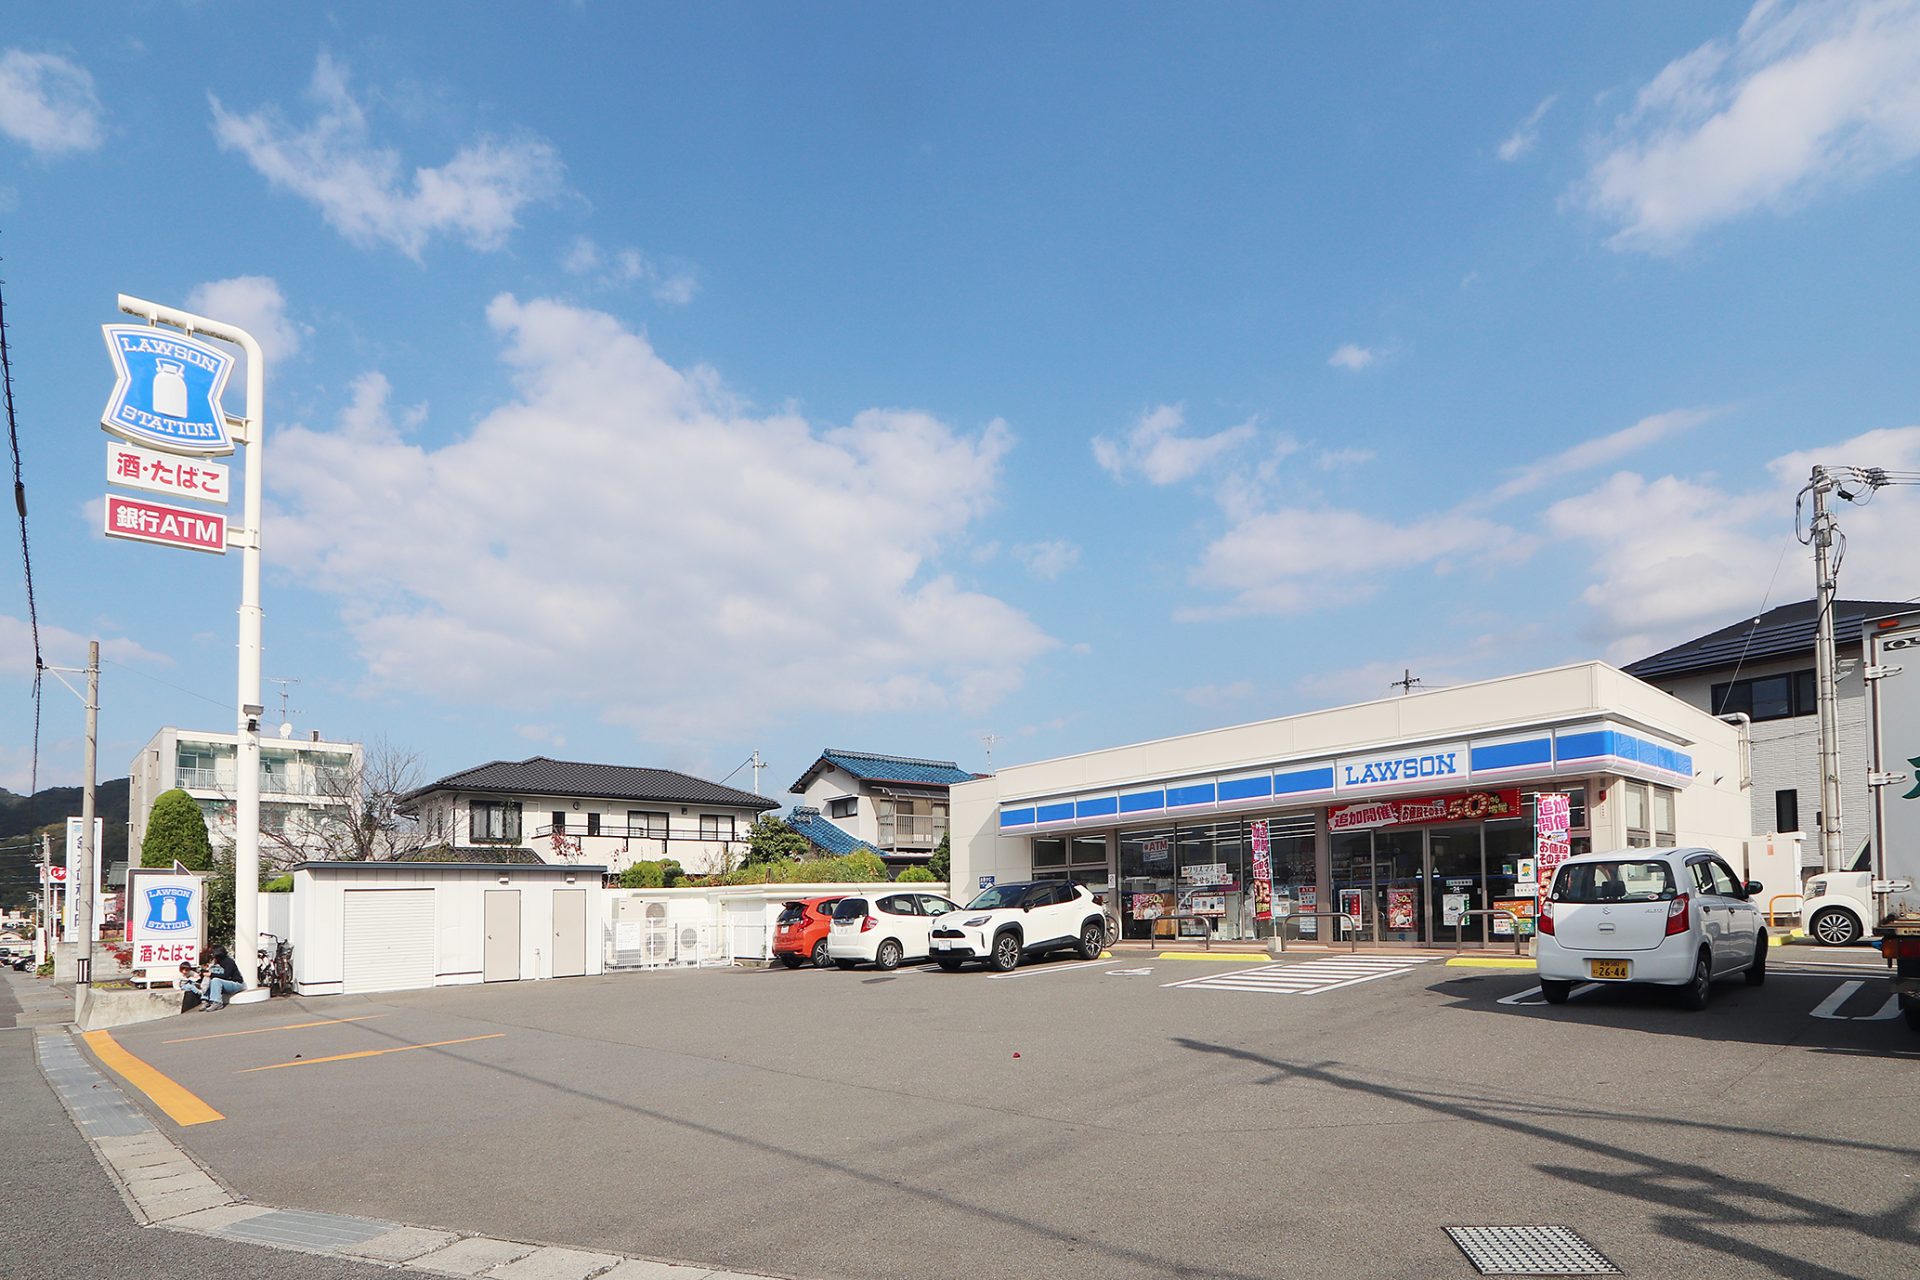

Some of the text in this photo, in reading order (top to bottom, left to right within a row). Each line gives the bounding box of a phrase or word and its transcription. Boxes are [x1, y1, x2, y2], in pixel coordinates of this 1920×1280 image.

[120, 337, 218, 373] LAWSON
[121, 405, 216, 437] STATION
[117, 451, 221, 494] 酒・たばこ
[116, 505, 217, 543] 銀行ATM
[1345, 753, 1456, 785] LAWSON
[1539, 798, 1569, 817] 追加
[1538, 814, 1568, 832] 開催
[1149, 840, 1168, 852] ATM
[1540, 841, 1568, 854] お値段
[148, 888, 191, 898] LAWSON
[147, 920, 189, 930] STATION
[140, 944, 195, 962] 酒・たばこ
[1599, 967, 1626, 977] 26-44
